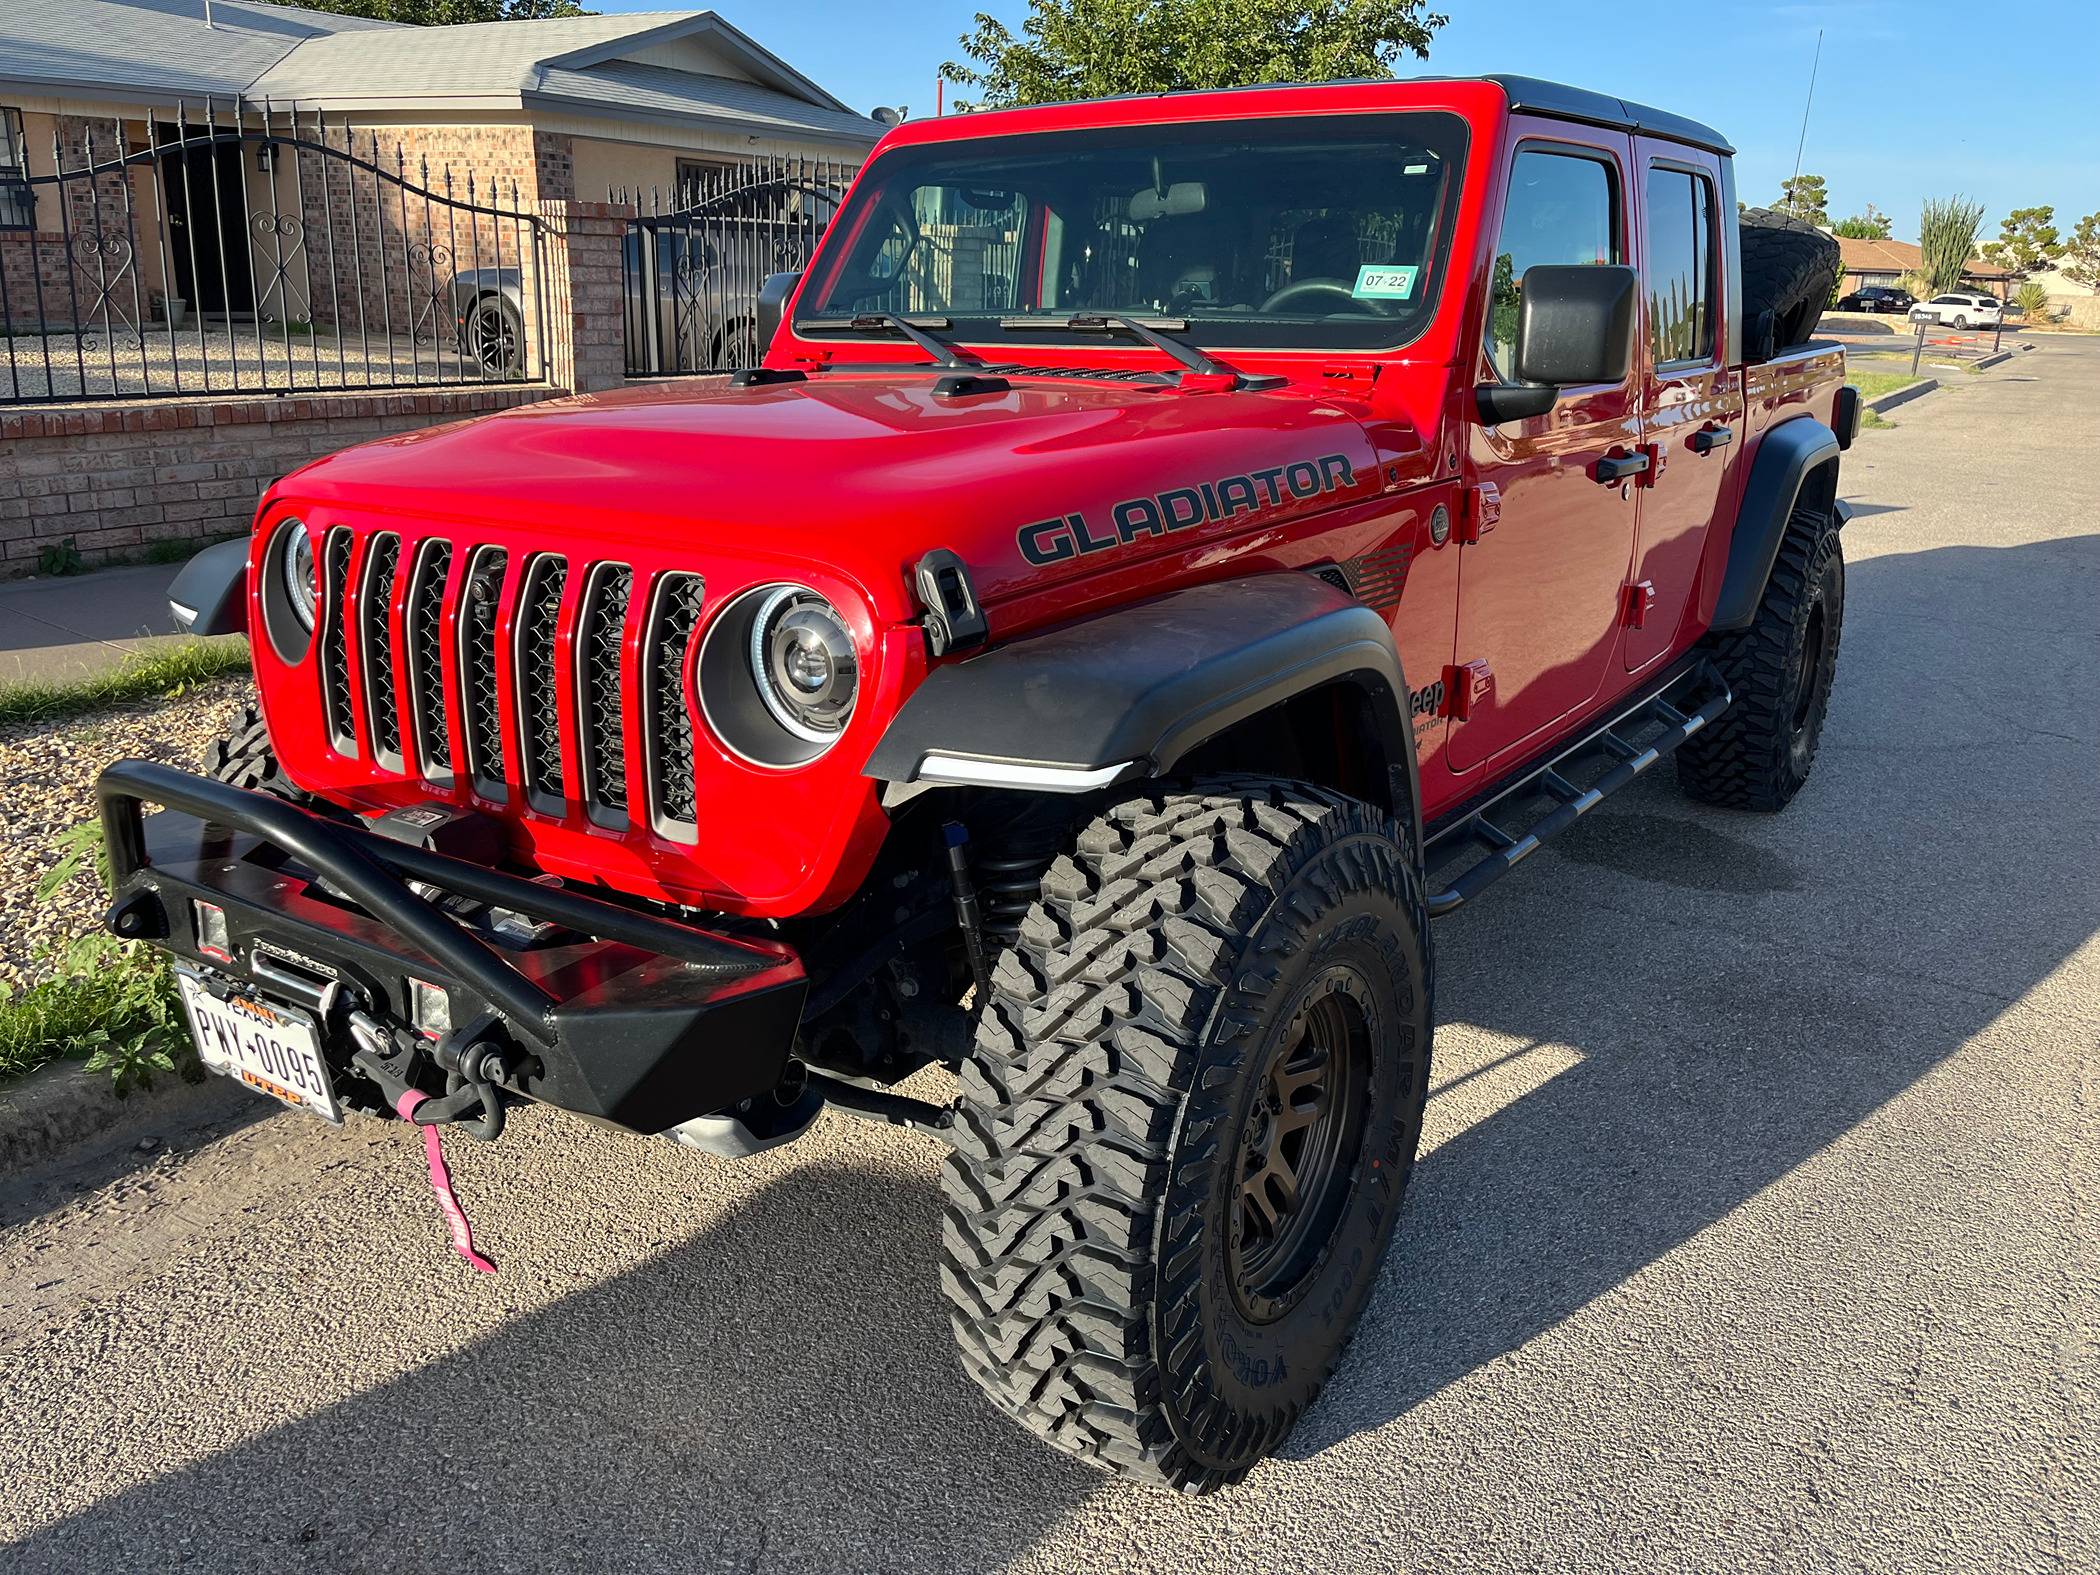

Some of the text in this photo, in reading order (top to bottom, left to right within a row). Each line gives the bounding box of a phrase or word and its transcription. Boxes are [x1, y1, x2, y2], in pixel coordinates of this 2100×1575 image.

[1016, 454, 1358, 567] GLADIATOR
[1408, 681, 1445, 718] eep
[242, 1070, 302, 1103] UTEP
